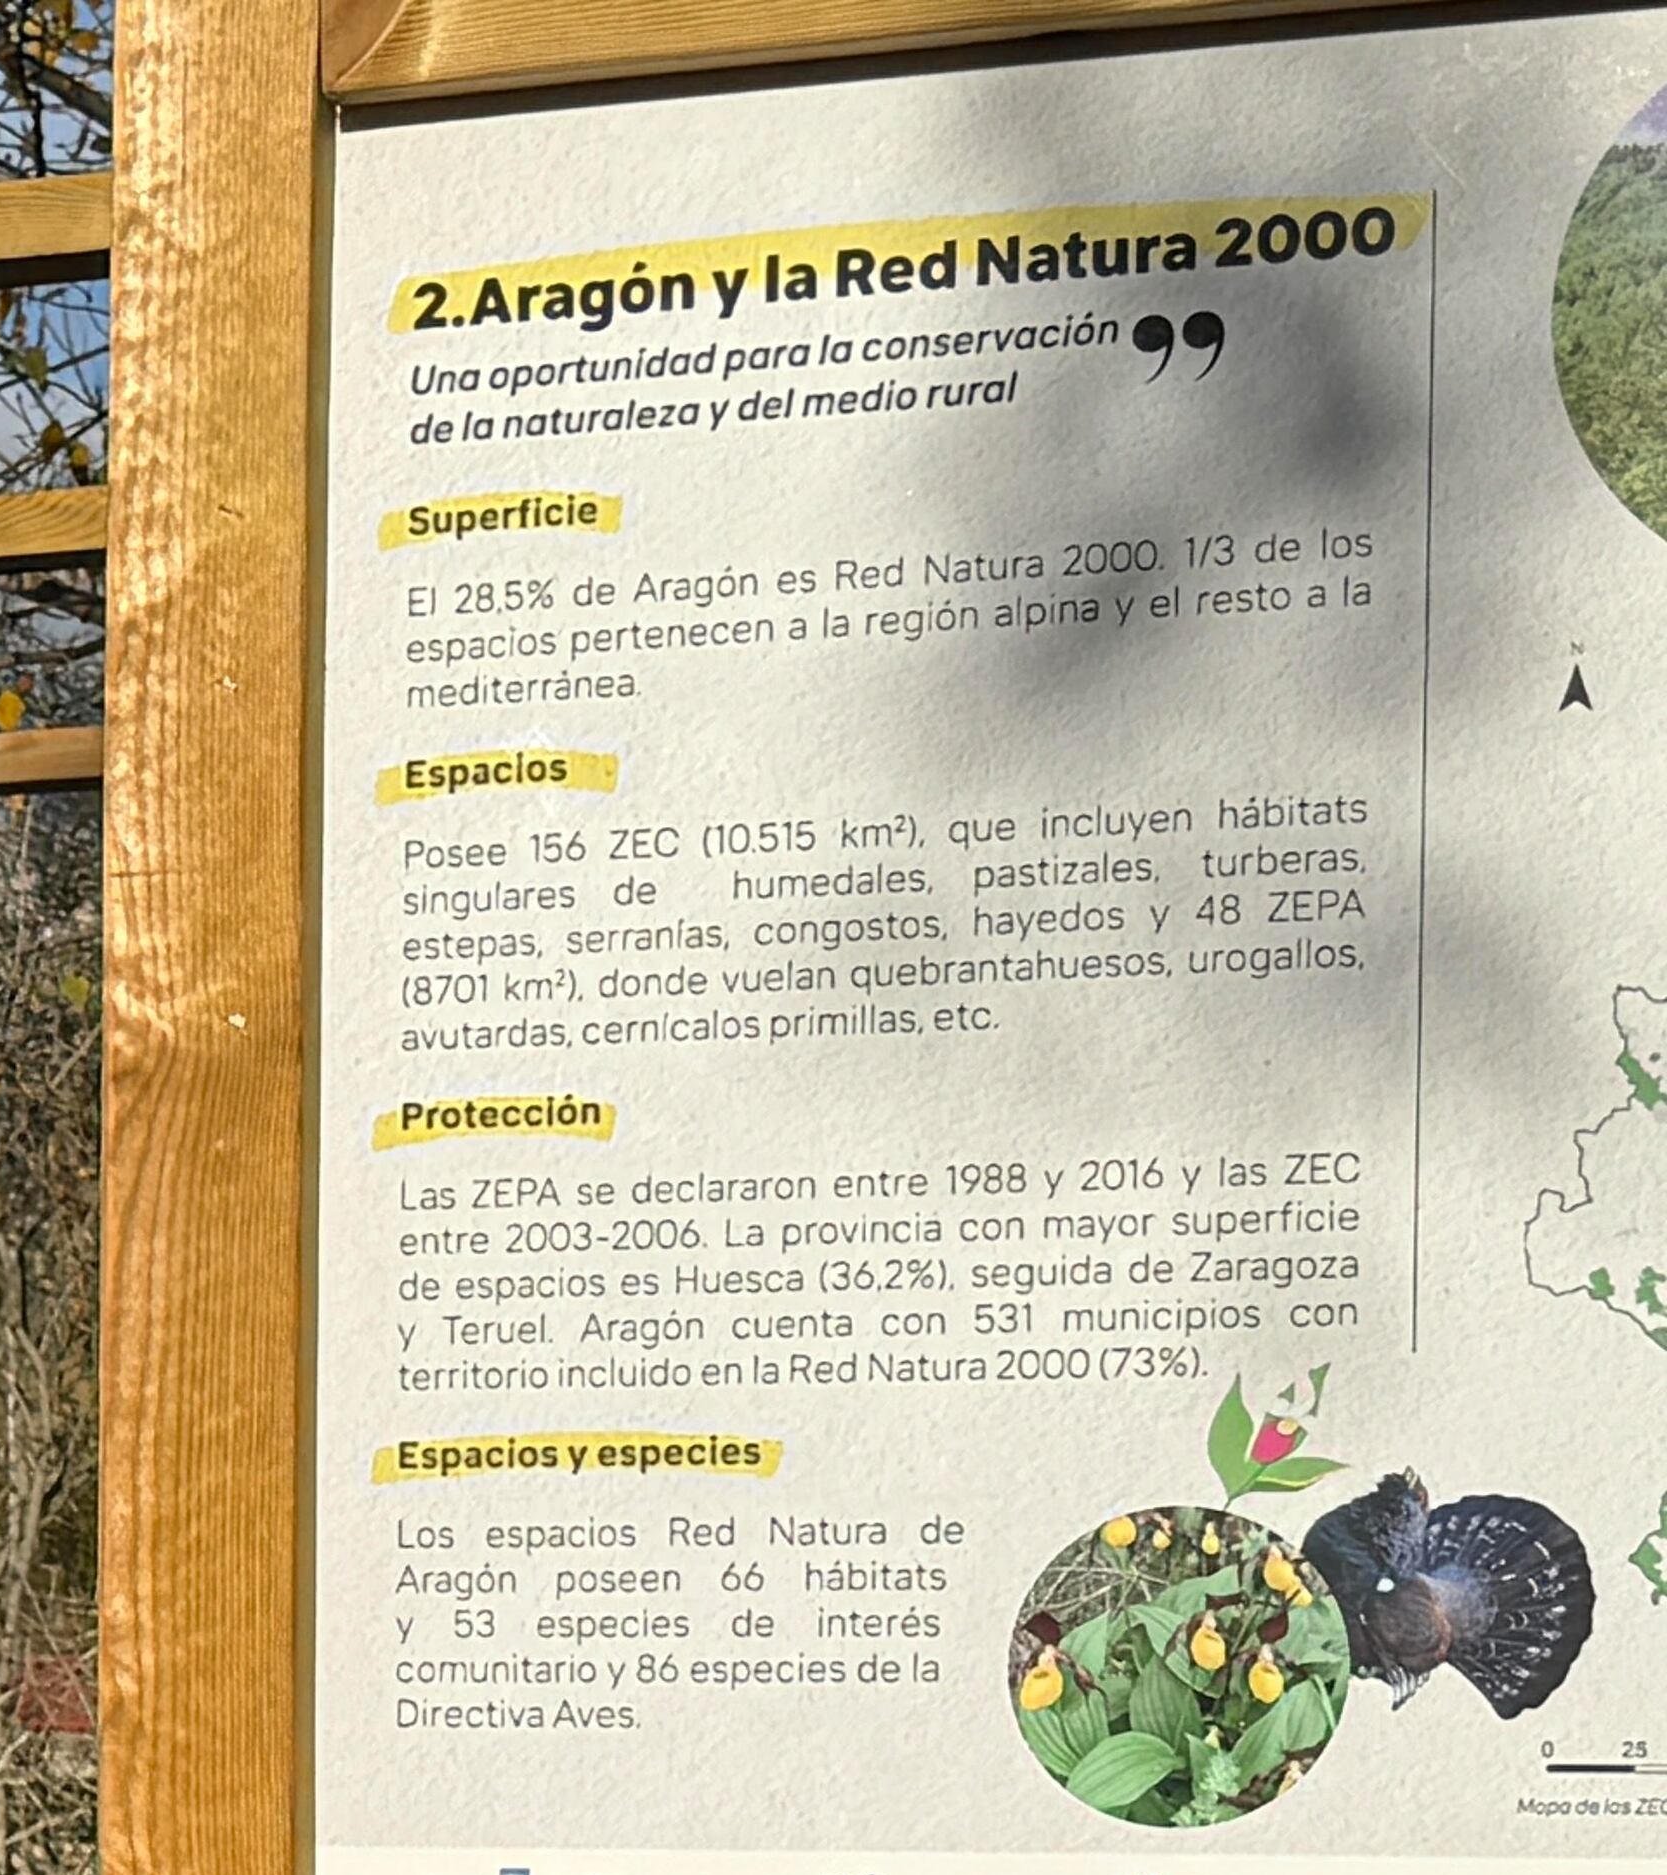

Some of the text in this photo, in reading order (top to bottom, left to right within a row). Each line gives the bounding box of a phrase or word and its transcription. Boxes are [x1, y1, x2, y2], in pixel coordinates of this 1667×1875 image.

[711, 267, 750, 321] y
[764, 253, 818, 304] la
[835, 238, 958, 299] Red
[975, 231, 1197, 287] Natura
[1214, 205, 1396, 269] 2000
[410, 310, 1120, 398] Una oportunidad para la conservación
[409, 369, 1019, 446] de la naturaleza y del medio rural
[409, 494, 597, 540] Superficie
[407, 585, 437, 618] El
[572, 575, 616, 608] de
[632, 564, 759, 609] Aragón
[776, 569, 817, 595] es
[835, 555, 905, 592] Red
[923, 552, 1044, 586] Natura
[1184, 534, 1236, 569] 1/3
[1254, 533, 1302, 564] de
[1321, 527, 1373, 561] los
[405, 574, 1372, 666] espacios pertenecen a la región alpina y el resto a la
[406, 753, 567, 794] Espacios
[404, 839, 508, 872] Posee
[529, 829, 587, 864] 156
[608, 826, 680, 861] ZEC
[702, 819, 817, 859] (10.515
[948, 817, 1016, 852] que
[1041, 804, 1193, 843] incluyen
[1218, 794, 1368, 830] hábitats
[402, 843, 1367, 922] singulares de humedales, pastizales, turberas,
[402, 887, 1366, 967] estepas, serranías, congostos, hayedos y 48 ZEPA
[401, 973, 488, 1009] (8701
[598, 964, 709, 999] donde
[721, 959, 837, 994] vuelan
[849, 948, 1173, 997] quebrantahuesos,
[1188, 936, 1365, 980] urogallos,
[400, 1002, 1000, 1052] avutardas, cernícalos primillas, etc.
[402, 1094, 600, 1130] Protección
[400, 1151, 1361, 1212] Las ZEPA se declararon entre 1988 y 2016 y las ZEC
[399, 1199, 1361, 1257] entre 2003-2006. La provincia con mayor superficie
[398, 1270, 441, 1302] de
[455, 1266, 606, 1307] espacios
[620, 1272, 660, 1297] es
[674, 1264, 805, 1295] Huesca
[970, 1253, 1113, 1296] seguida
[1128, 1251, 1174, 1285] de
[1189, 1250, 1360, 1290] Zaragoza
[397, 1297, 1358, 1353] y Teruel. Aragón cuenta con 531 municipios con
[397, 1345, 1209, 1392] territorio incluido en la Red Natura 2000 (73%).
[399, 1435, 760, 1477] Espacios y especies
[397, 1513, 965, 1557] Los espacios Red Natura de
[395, 1651, 940, 1692] comunitario y 86 especies de la
[396, 1697, 642, 1730] Directiva Aves.
[1540, 1741, 1648, 1758] 0 25
[1517, 1798, 1572, 1817] Mapa
[1575, 1798, 1600, 1815] de
[1603, 1798, 1632, 1815] las
